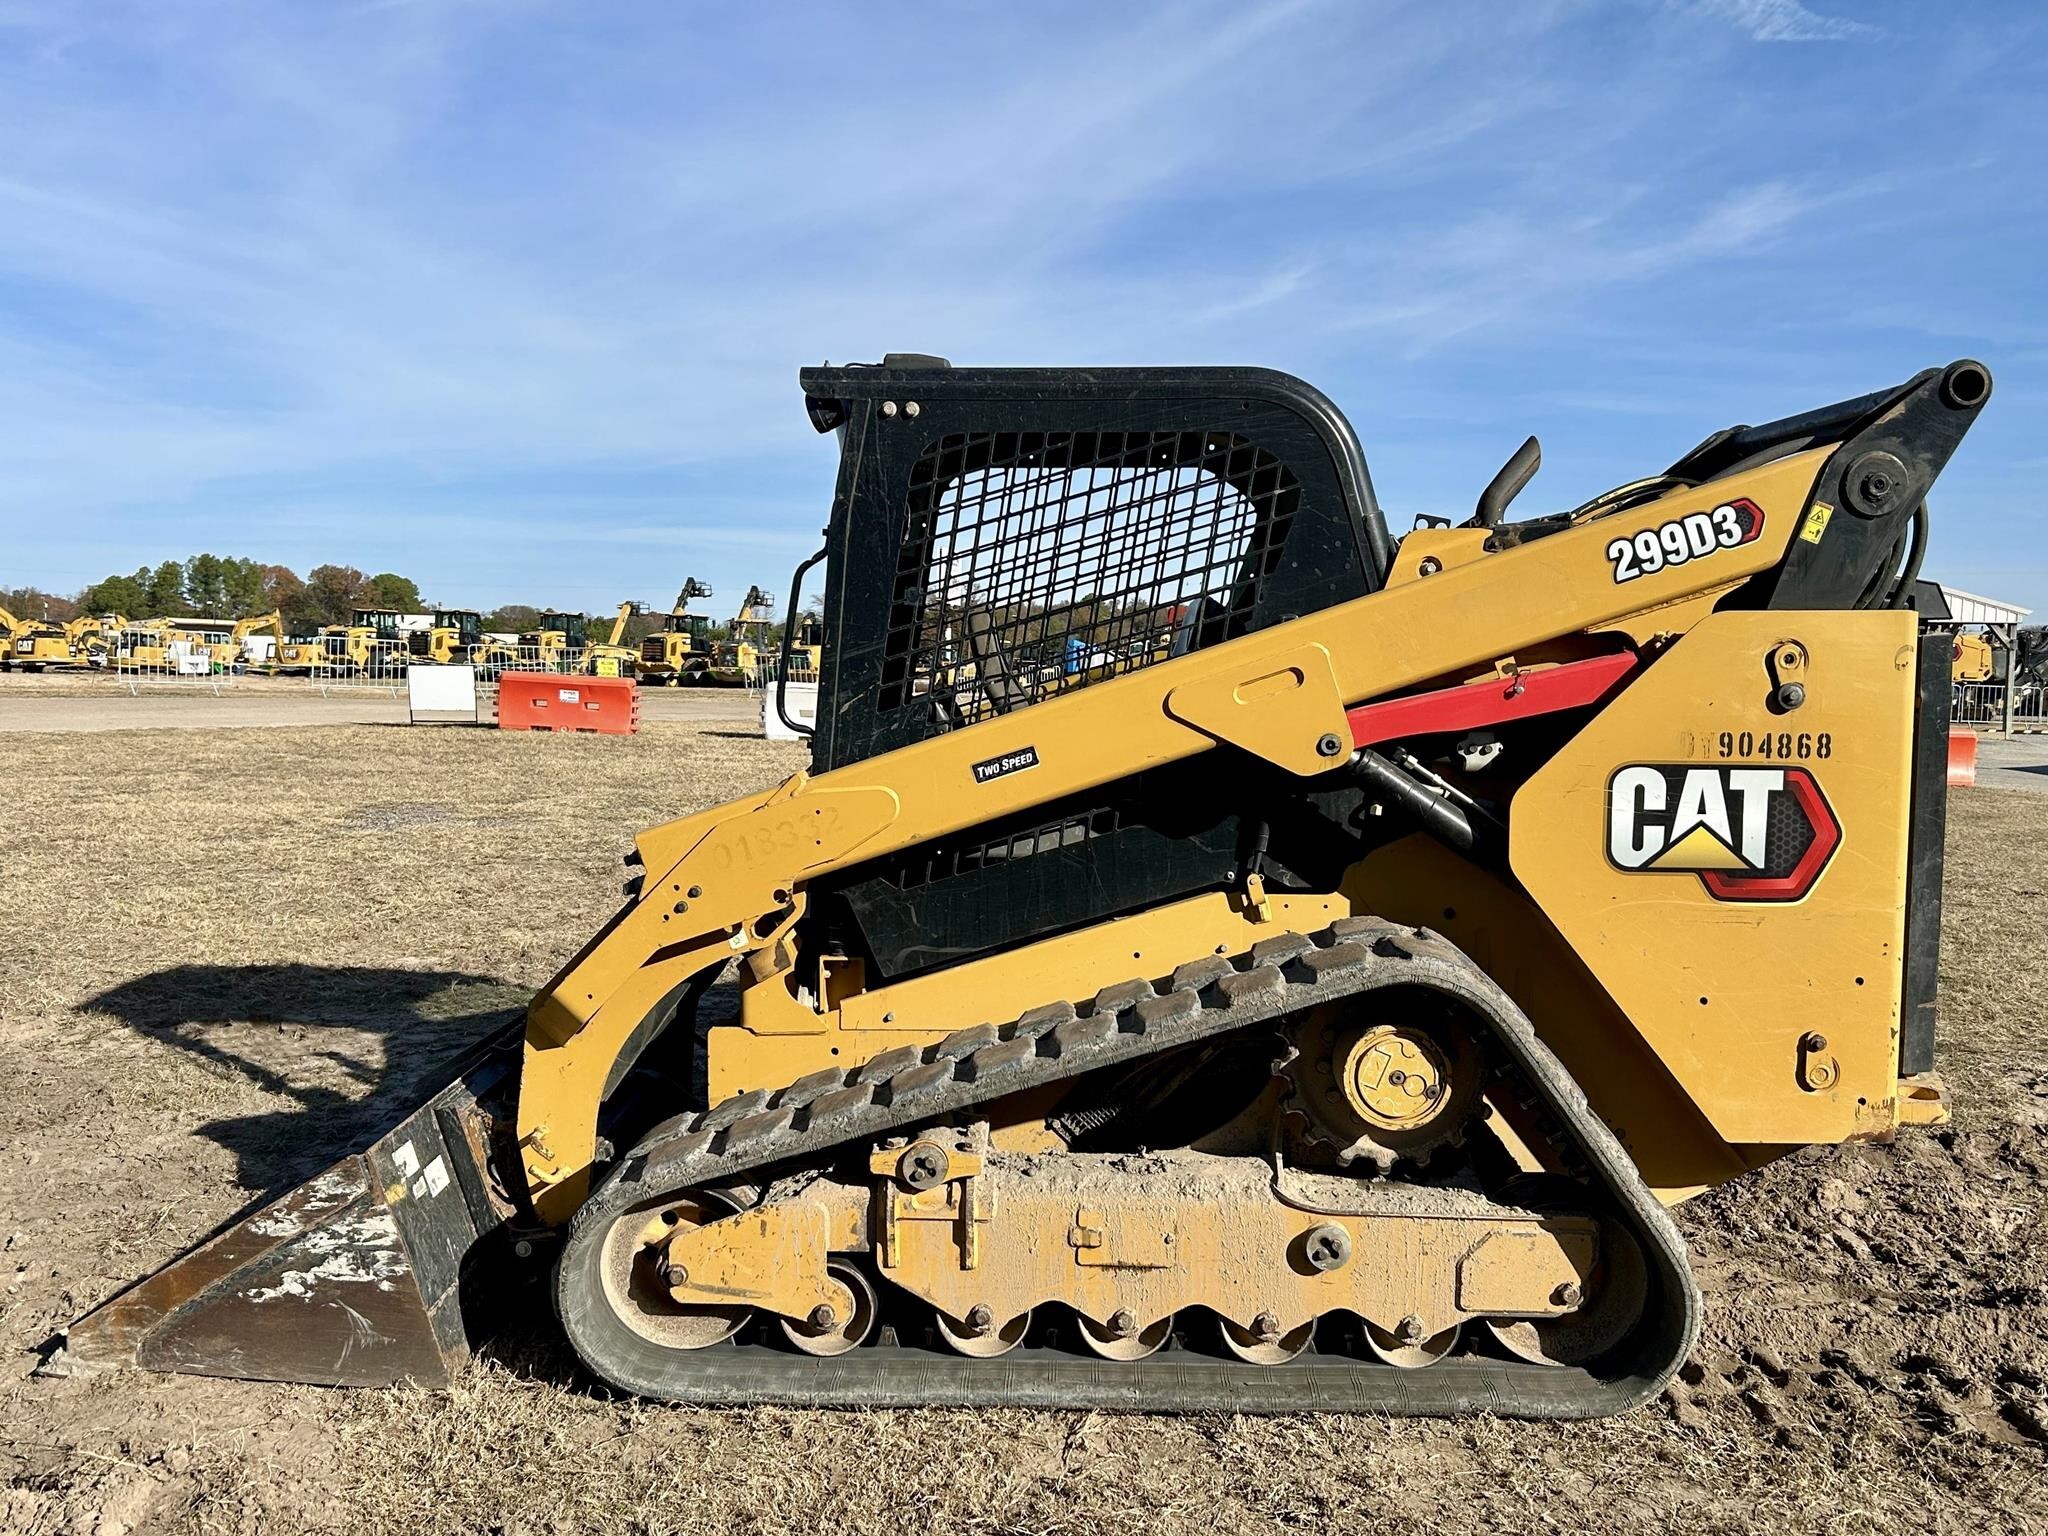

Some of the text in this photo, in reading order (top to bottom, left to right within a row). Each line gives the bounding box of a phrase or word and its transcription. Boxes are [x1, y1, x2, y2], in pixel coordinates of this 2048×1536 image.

[1608, 505, 1744, 583] 299D3
[18, 640, 34, 651] CAT
[1682, 731, 1832, 759] 904868
[977, 753, 1033, 778] TWO SPEED
[1609, 766, 1784, 870] CAT
